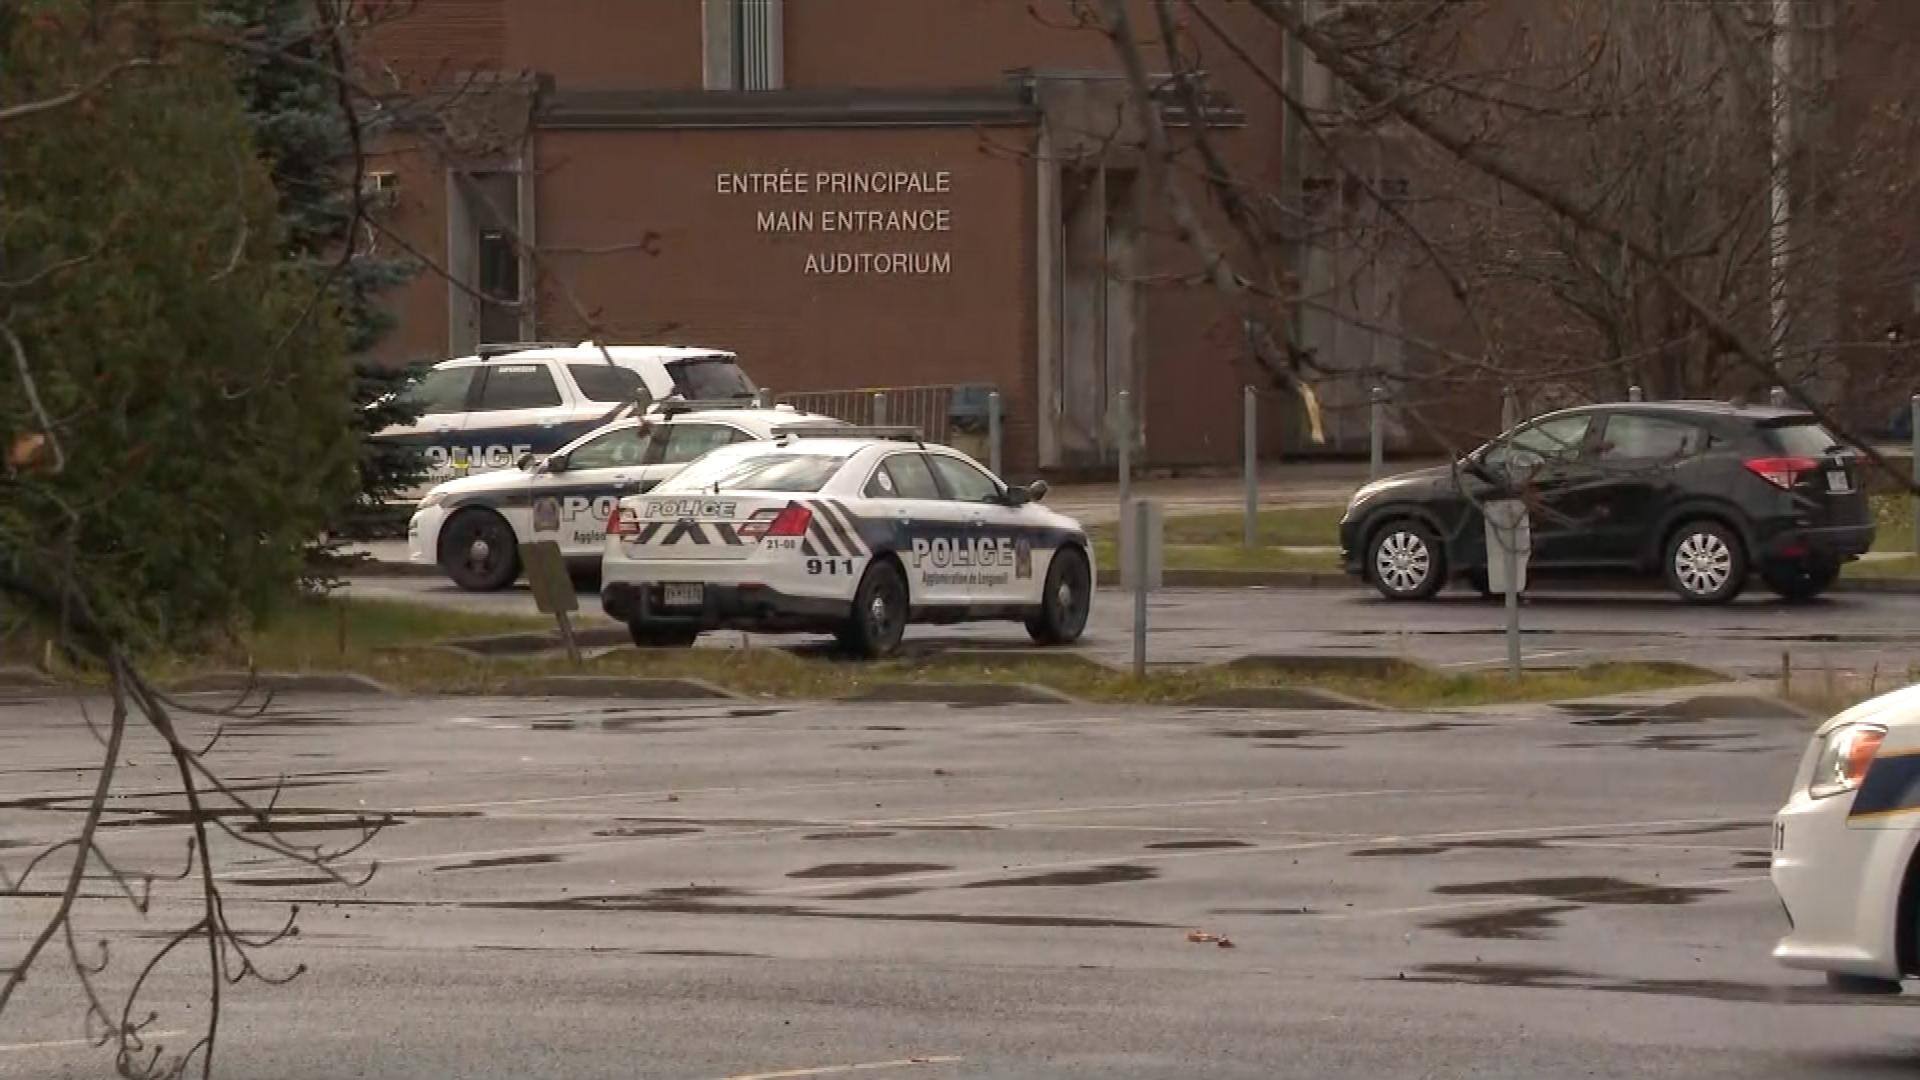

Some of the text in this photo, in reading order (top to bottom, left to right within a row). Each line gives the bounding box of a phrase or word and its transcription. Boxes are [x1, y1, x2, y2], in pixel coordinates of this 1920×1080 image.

[716, 168, 951, 194] ENTRÉE PRINCIPALE
[756, 209, 951, 232] MAIN ENTRANCE
[803, 252, 951, 274] AUDITORIUM
[423, 444, 533, 469] OLICE
[644, 499, 737, 519] POLICE
[911, 537, 1014, 569] POLICE
[806, 558, 854, 575] 911
